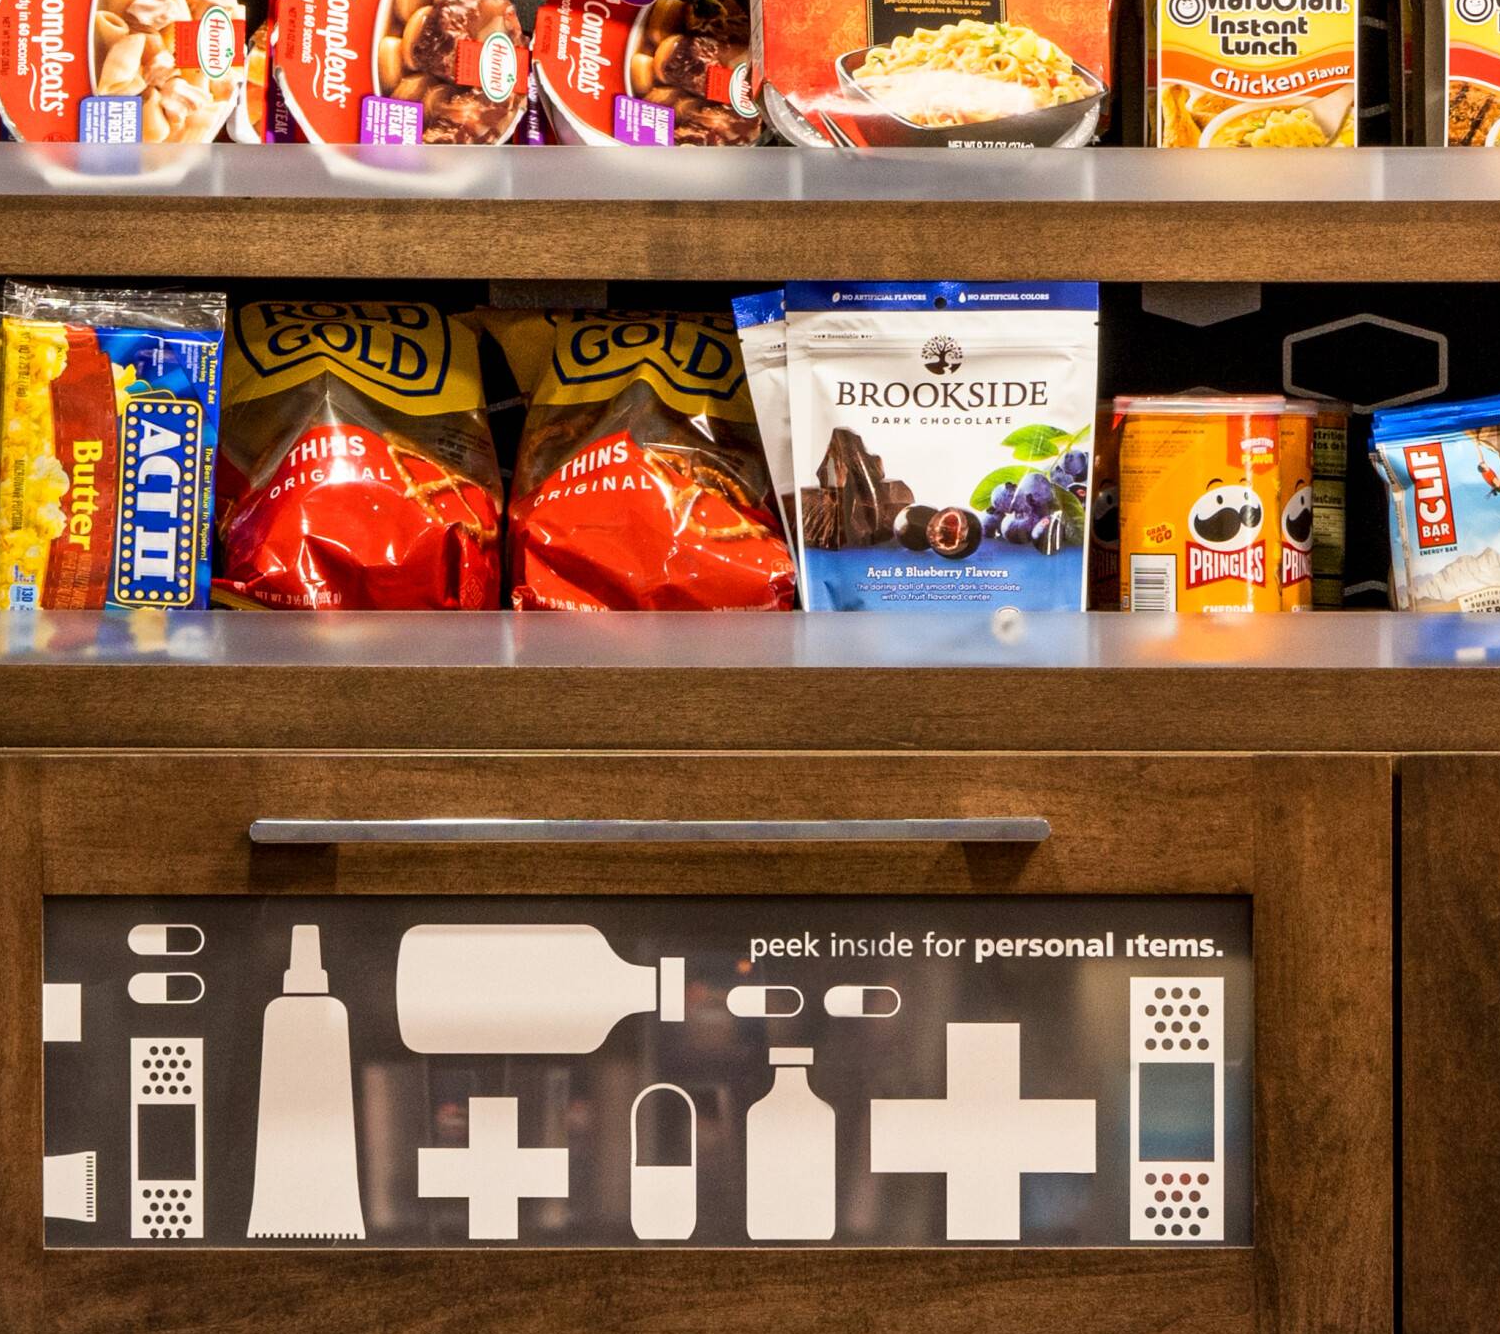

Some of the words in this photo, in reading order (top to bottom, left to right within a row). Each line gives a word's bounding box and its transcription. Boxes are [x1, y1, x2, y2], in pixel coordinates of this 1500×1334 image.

[18, 23, 29, 35] 60
[1210, 15, 1308, 39] Instant
[17, 37, 29, 76] seconds
[209, 18, 226, 71] Hormel
[1221, 35, 1298, 57] Lunch
[1210, 67, 1306, 94] Chicken
[1307, 64, 1351, 81] Flavor
[388, 104, 402, 137] STEAK
[1020, 293, 1050, 301] COLORS
[256, 303, 430, 332] ROLD
[267, 321, 428, 381] GOLD
[570, 322, 735, 381] GOLD
[208, 360, 219, 387] Trans
[207, 390, 217, 405] Fat
[835, 381, 1048, 411] BROOKSIDE
[872, 417, 911, 425] DARK
[920, 417, 1011, 425] CHOCOLATE
[288, 434, 367, 468] THINS
[559, 440, 630, 483] THINS
[137, 419, 182, 518] ACT
[69, 440, 103, 551] Butter
[533, 479, 652, 507] ORIGINAL
[1409, 451, 1446, 523] CLIF
[1422, 523, 1450, 538] BAR
[133, 526, 177, 581] II
[1190, 545, 1264, 584] PRINGLES
[1420, 548, 1443, 556] ENERGY
[867, 567, 892, 580] Açaí
[894, 567, 902, 578] &
[906, 567, 962, 580] Blueberry
[965, 567, 1008, 578] Flavors
[749, 933, 820, 964] peek
[826, 932, 914, 960] inside
[921, 931, 965, 959] for
[973, 933, 1107, 965] personal
[1123, 933, 1225, 959] items.
